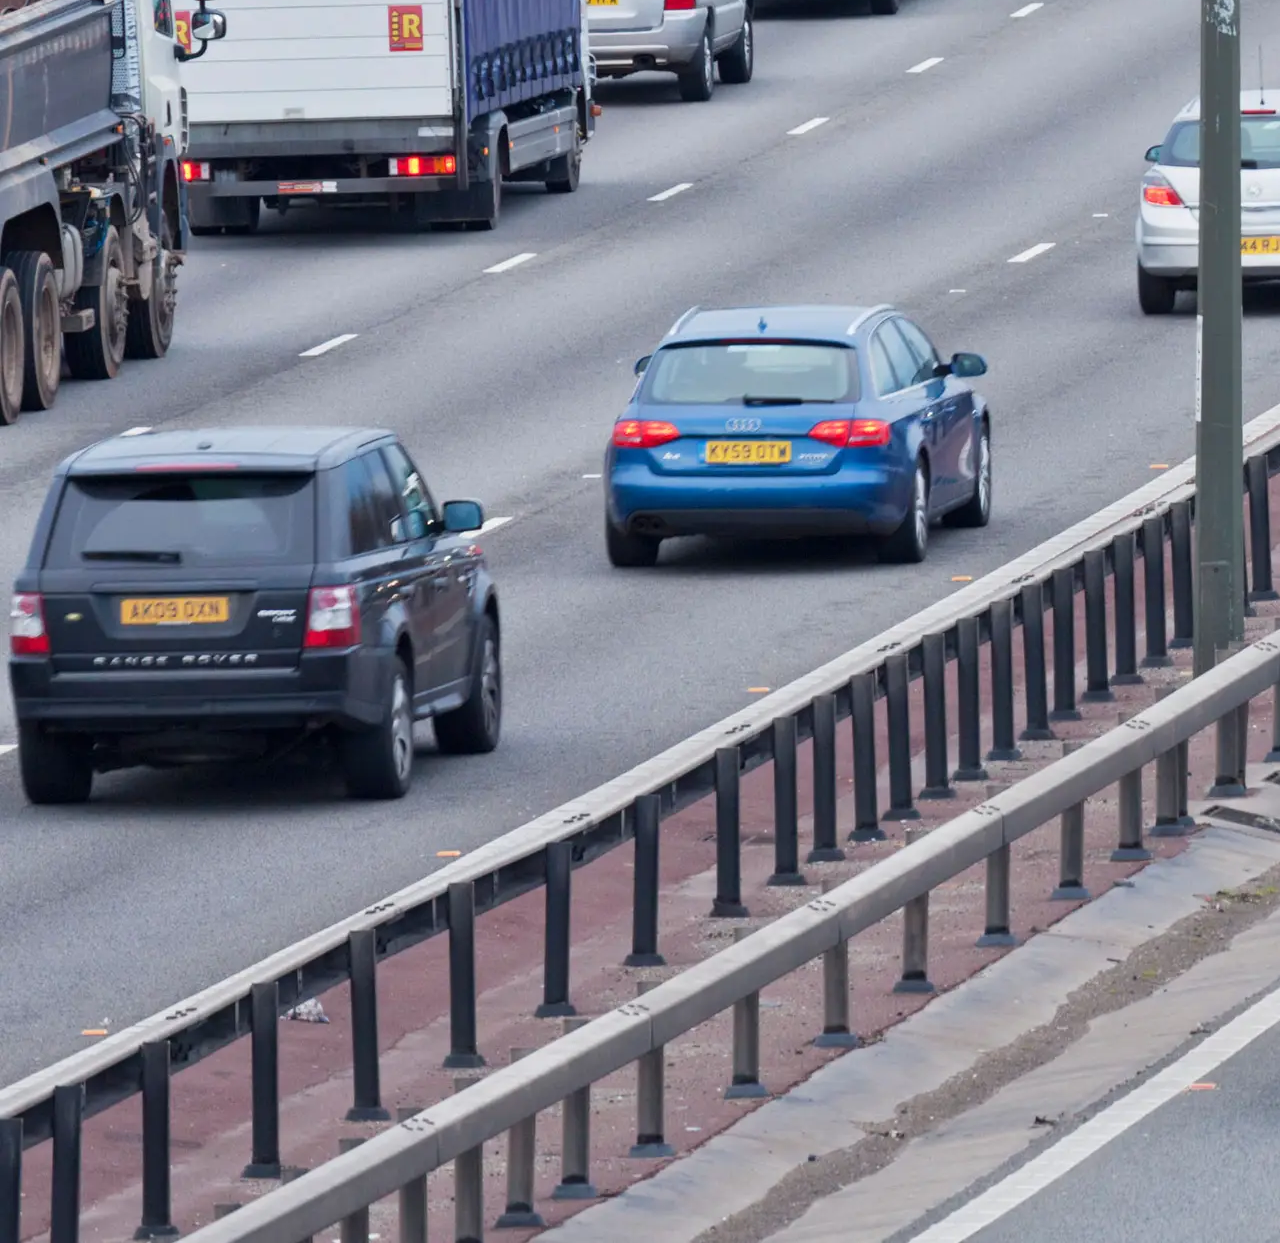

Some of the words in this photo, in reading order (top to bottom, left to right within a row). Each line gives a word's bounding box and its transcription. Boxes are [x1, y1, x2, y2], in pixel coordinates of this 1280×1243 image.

[402, 13, 421, 38] R
[708, 444, 753, 459] KY59
[756, 444, 788, 459] OTW
[129, 601, 178, 620] AK09
[93, 655, 169, 667] RANGE
[181, 653, 259, 665] ROVER
